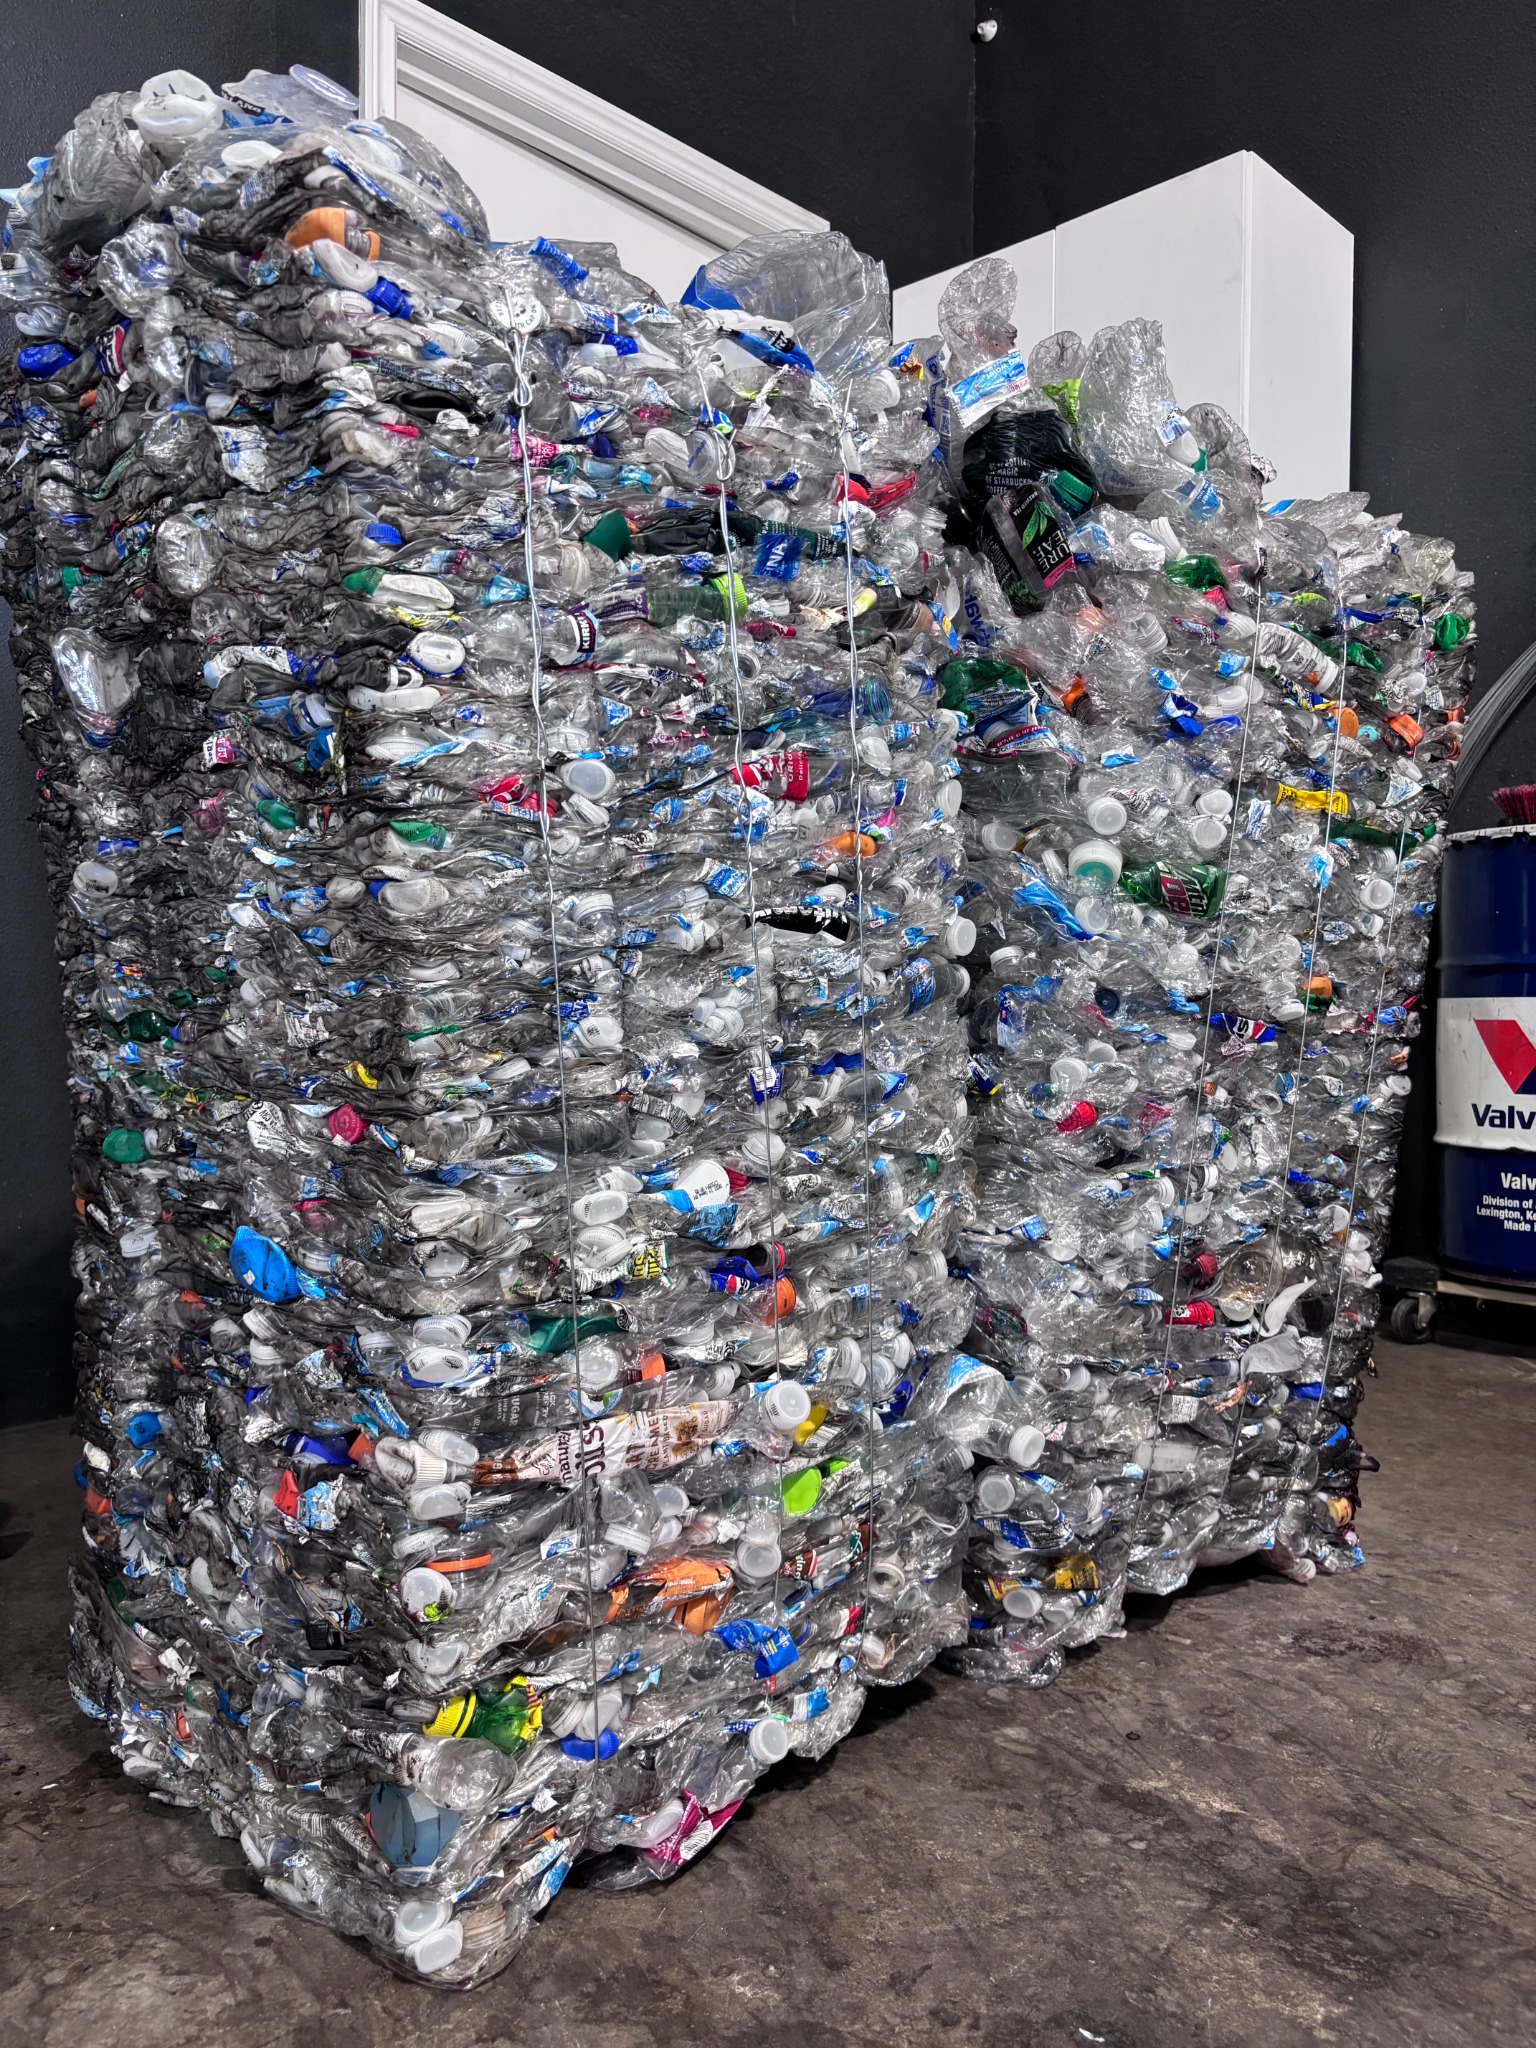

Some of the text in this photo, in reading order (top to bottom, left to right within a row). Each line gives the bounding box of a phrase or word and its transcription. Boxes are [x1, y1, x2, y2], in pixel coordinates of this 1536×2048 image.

[997, 468, 1019, 476] MAGIC
[1012, 507, 1022, 517] TEA
[1036, 529, 1061, 557] EAF
[1039, 543, 1070, 573] URE
[1471, 1103, 1536, 1130] Valv
[1482, 1194, 1533, 1209] Division of
[1476, 1205, 1524, 1221] Lexington,
[1503, 1219, 1531, 1231] Made
[645, 1410, 660, 1470] CREAMER
[661, 1445, 669, 1468] PLANT
